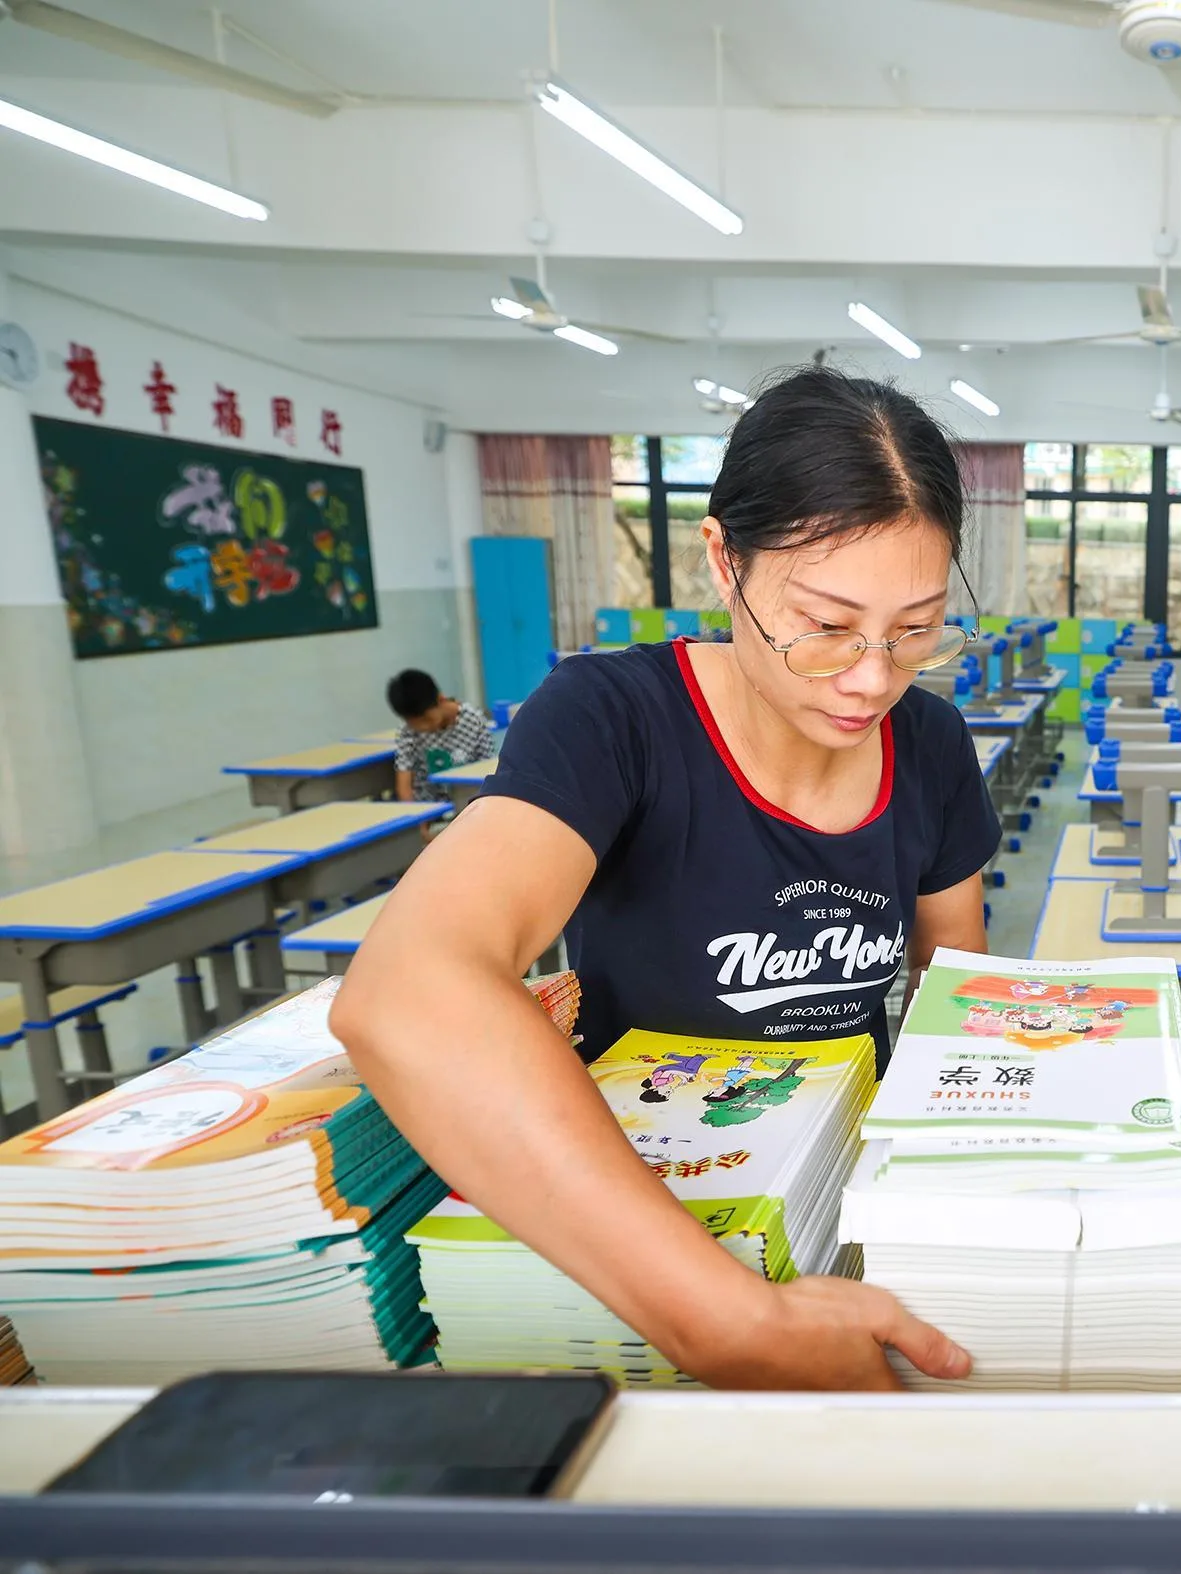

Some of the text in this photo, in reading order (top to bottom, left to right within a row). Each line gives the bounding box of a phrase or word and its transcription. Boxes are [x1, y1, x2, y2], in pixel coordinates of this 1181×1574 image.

[830, 882, 890, 910] QUALITY
[803, 907, 852, 920] SINCE 1989
[706, 920, 905, 986] New York
[780, 1001, 862, 1017] BROOKLYN
[807, 1024, 828, 1032] AND
[829, 1011, 871, 1031] STRENGTH
[938, 1065, 1036, 1087] 数学
[928, 1090, 1032, 1100] SHUXUE
